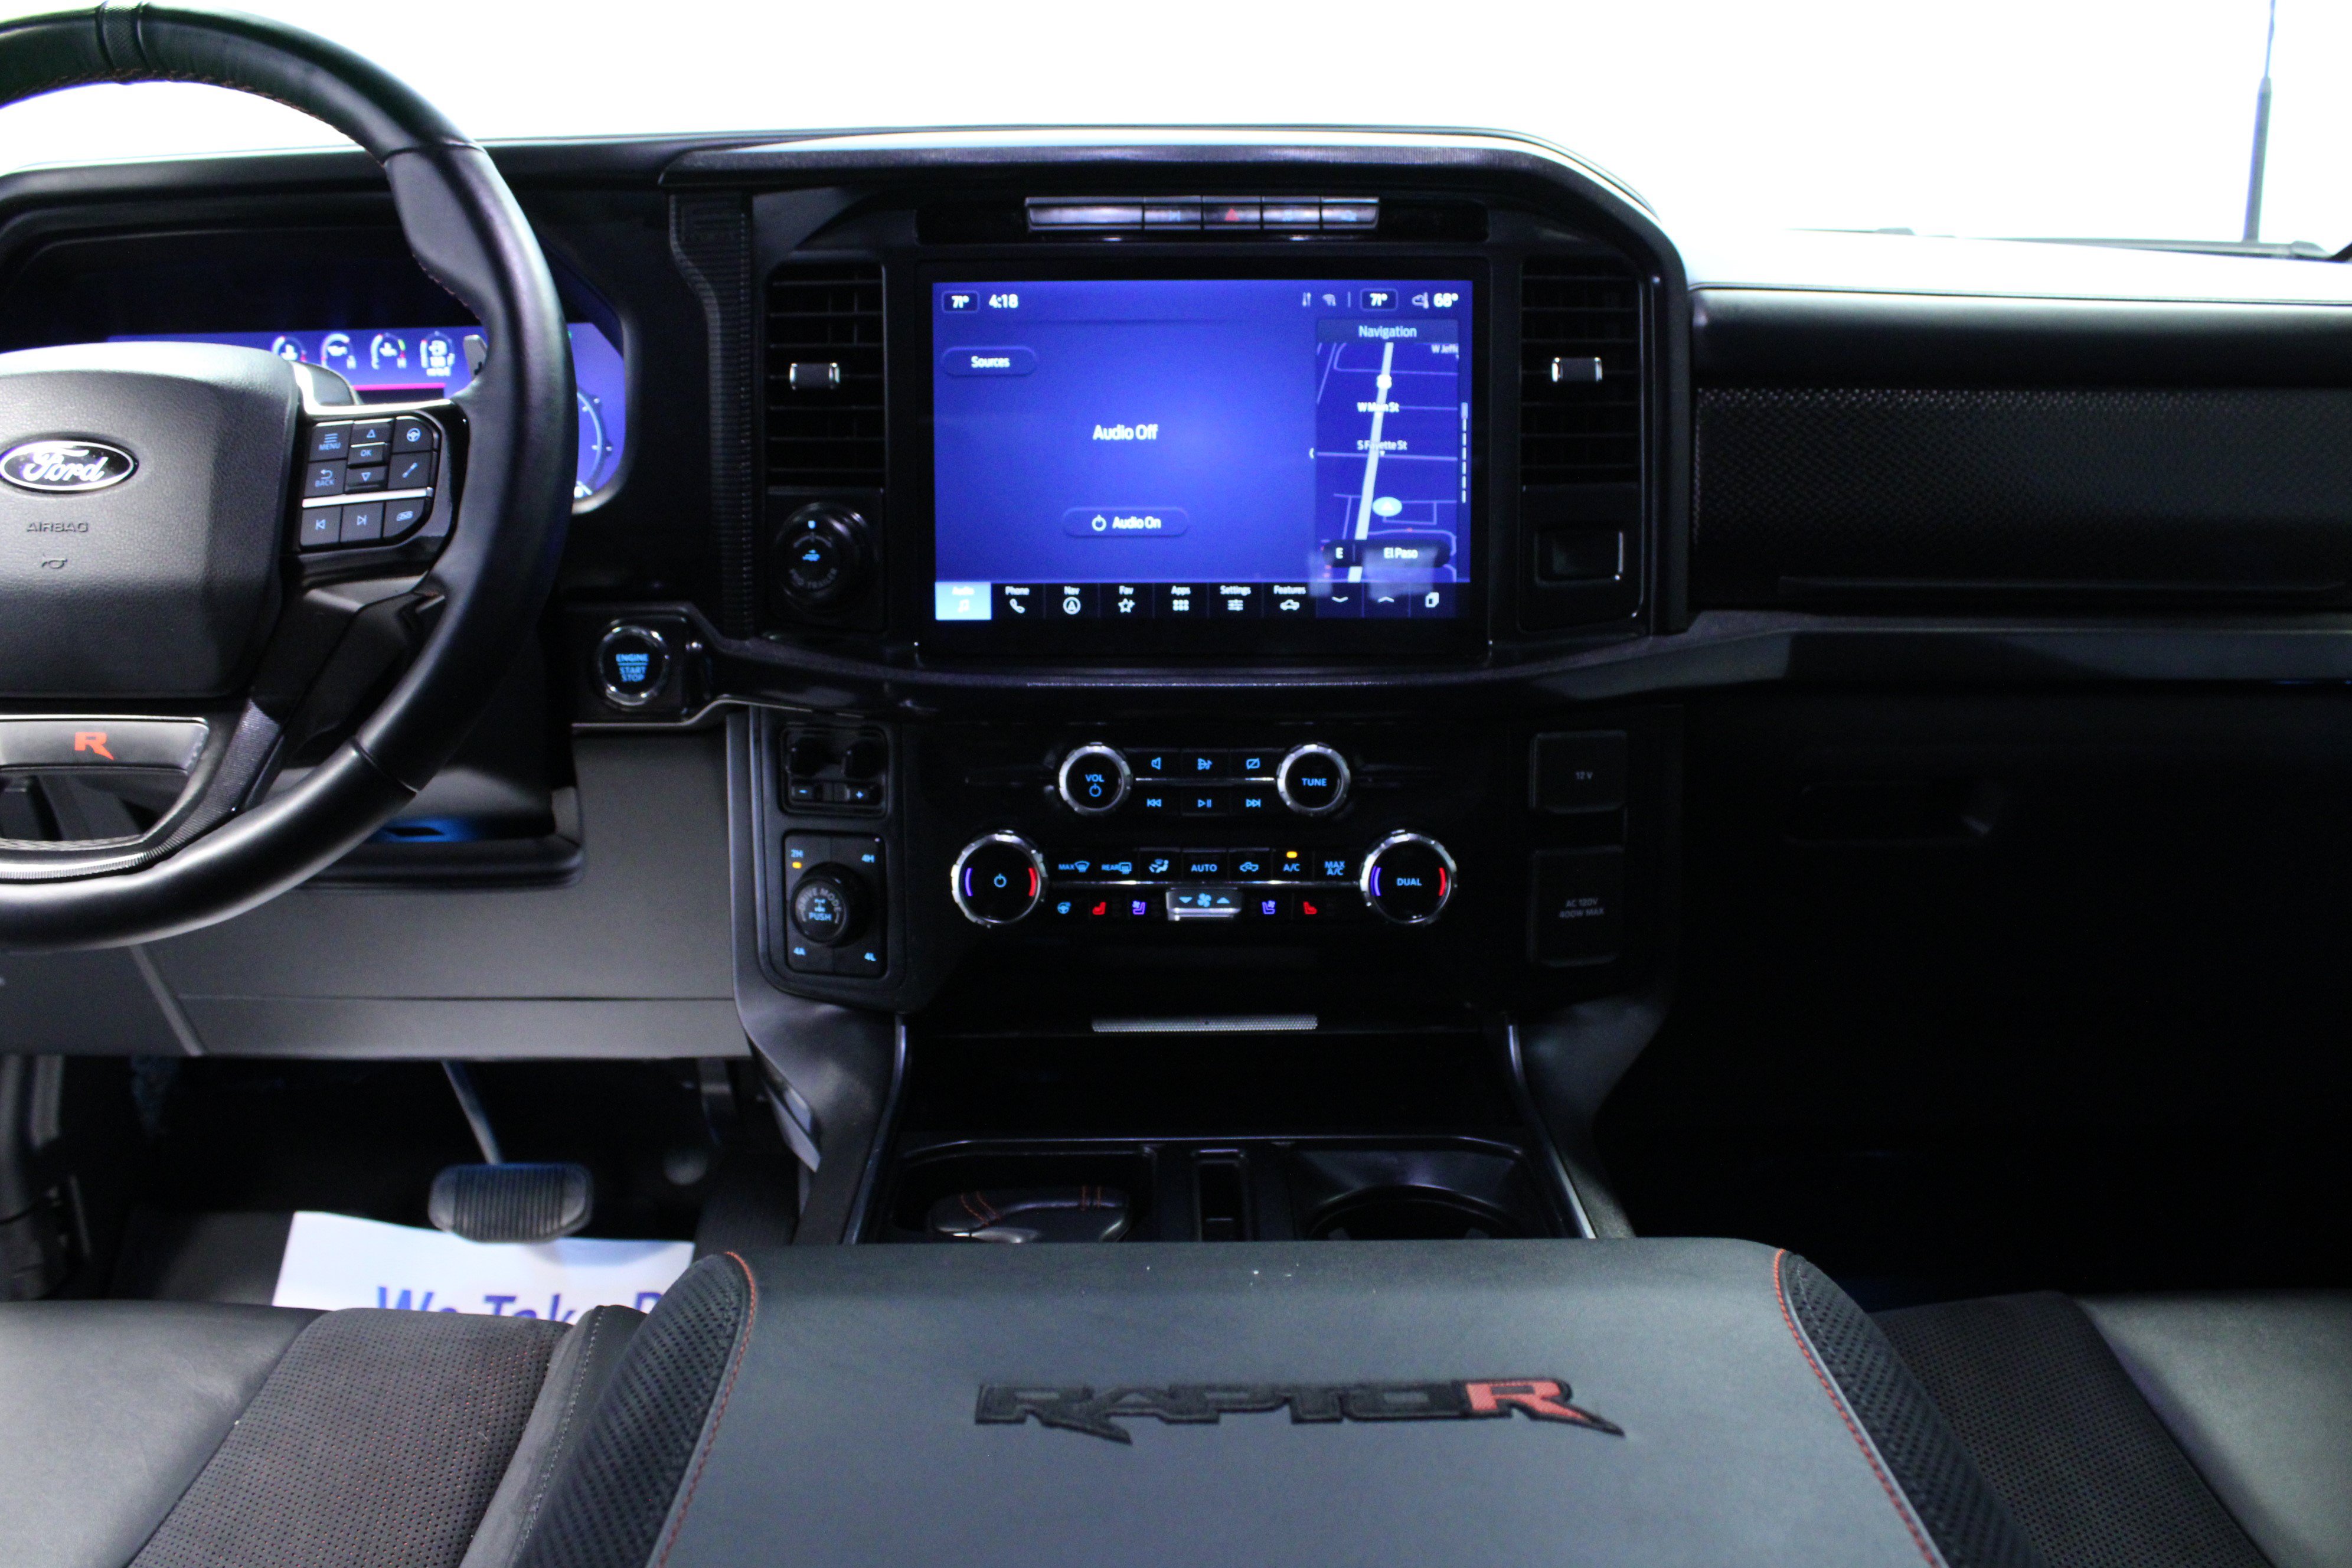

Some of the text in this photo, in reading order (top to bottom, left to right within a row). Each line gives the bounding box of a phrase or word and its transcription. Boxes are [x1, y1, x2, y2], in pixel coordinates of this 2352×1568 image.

[989, 294, 1018, 309] 4:18
[1358, 325, 1417, 340] Navigation
[971, 356, 1010, 368] Sources
[1357, 402, 1367, 412] W
[1389, 401, 1400, 412] St
[1093, 423, 1158, 440] Audio Off
[1357, 440, 1364, 450] S
[1397, 440, 1407, 450] St
[22, 445, 109, 482] Ford
[315, 479, 335, 488] BACK
[27, 521, 89, 533] AIRBAG
[1112, 515, 1161, 530] Audio On
[1335, 547, 1343, 559] E
[1384, 547, 1418, 559] El Paso
[1171, 586, 1191, 596] Apps
[1220, 585, 1251, 596] Settings
[74, 731, 115, 760] R
[1085, 774, 1105, 782] VOL
[1302, 778, 1327, 786] TUNE
[1191, 864, 1217, 873] AUTO
[1283, 863, 1300, 872] A/C
[1327, 868, 1344, 876] A/C
[1396, 878, 1422, 887] DUAL
[975, 1378, 1626, 1445] RAPTOR
